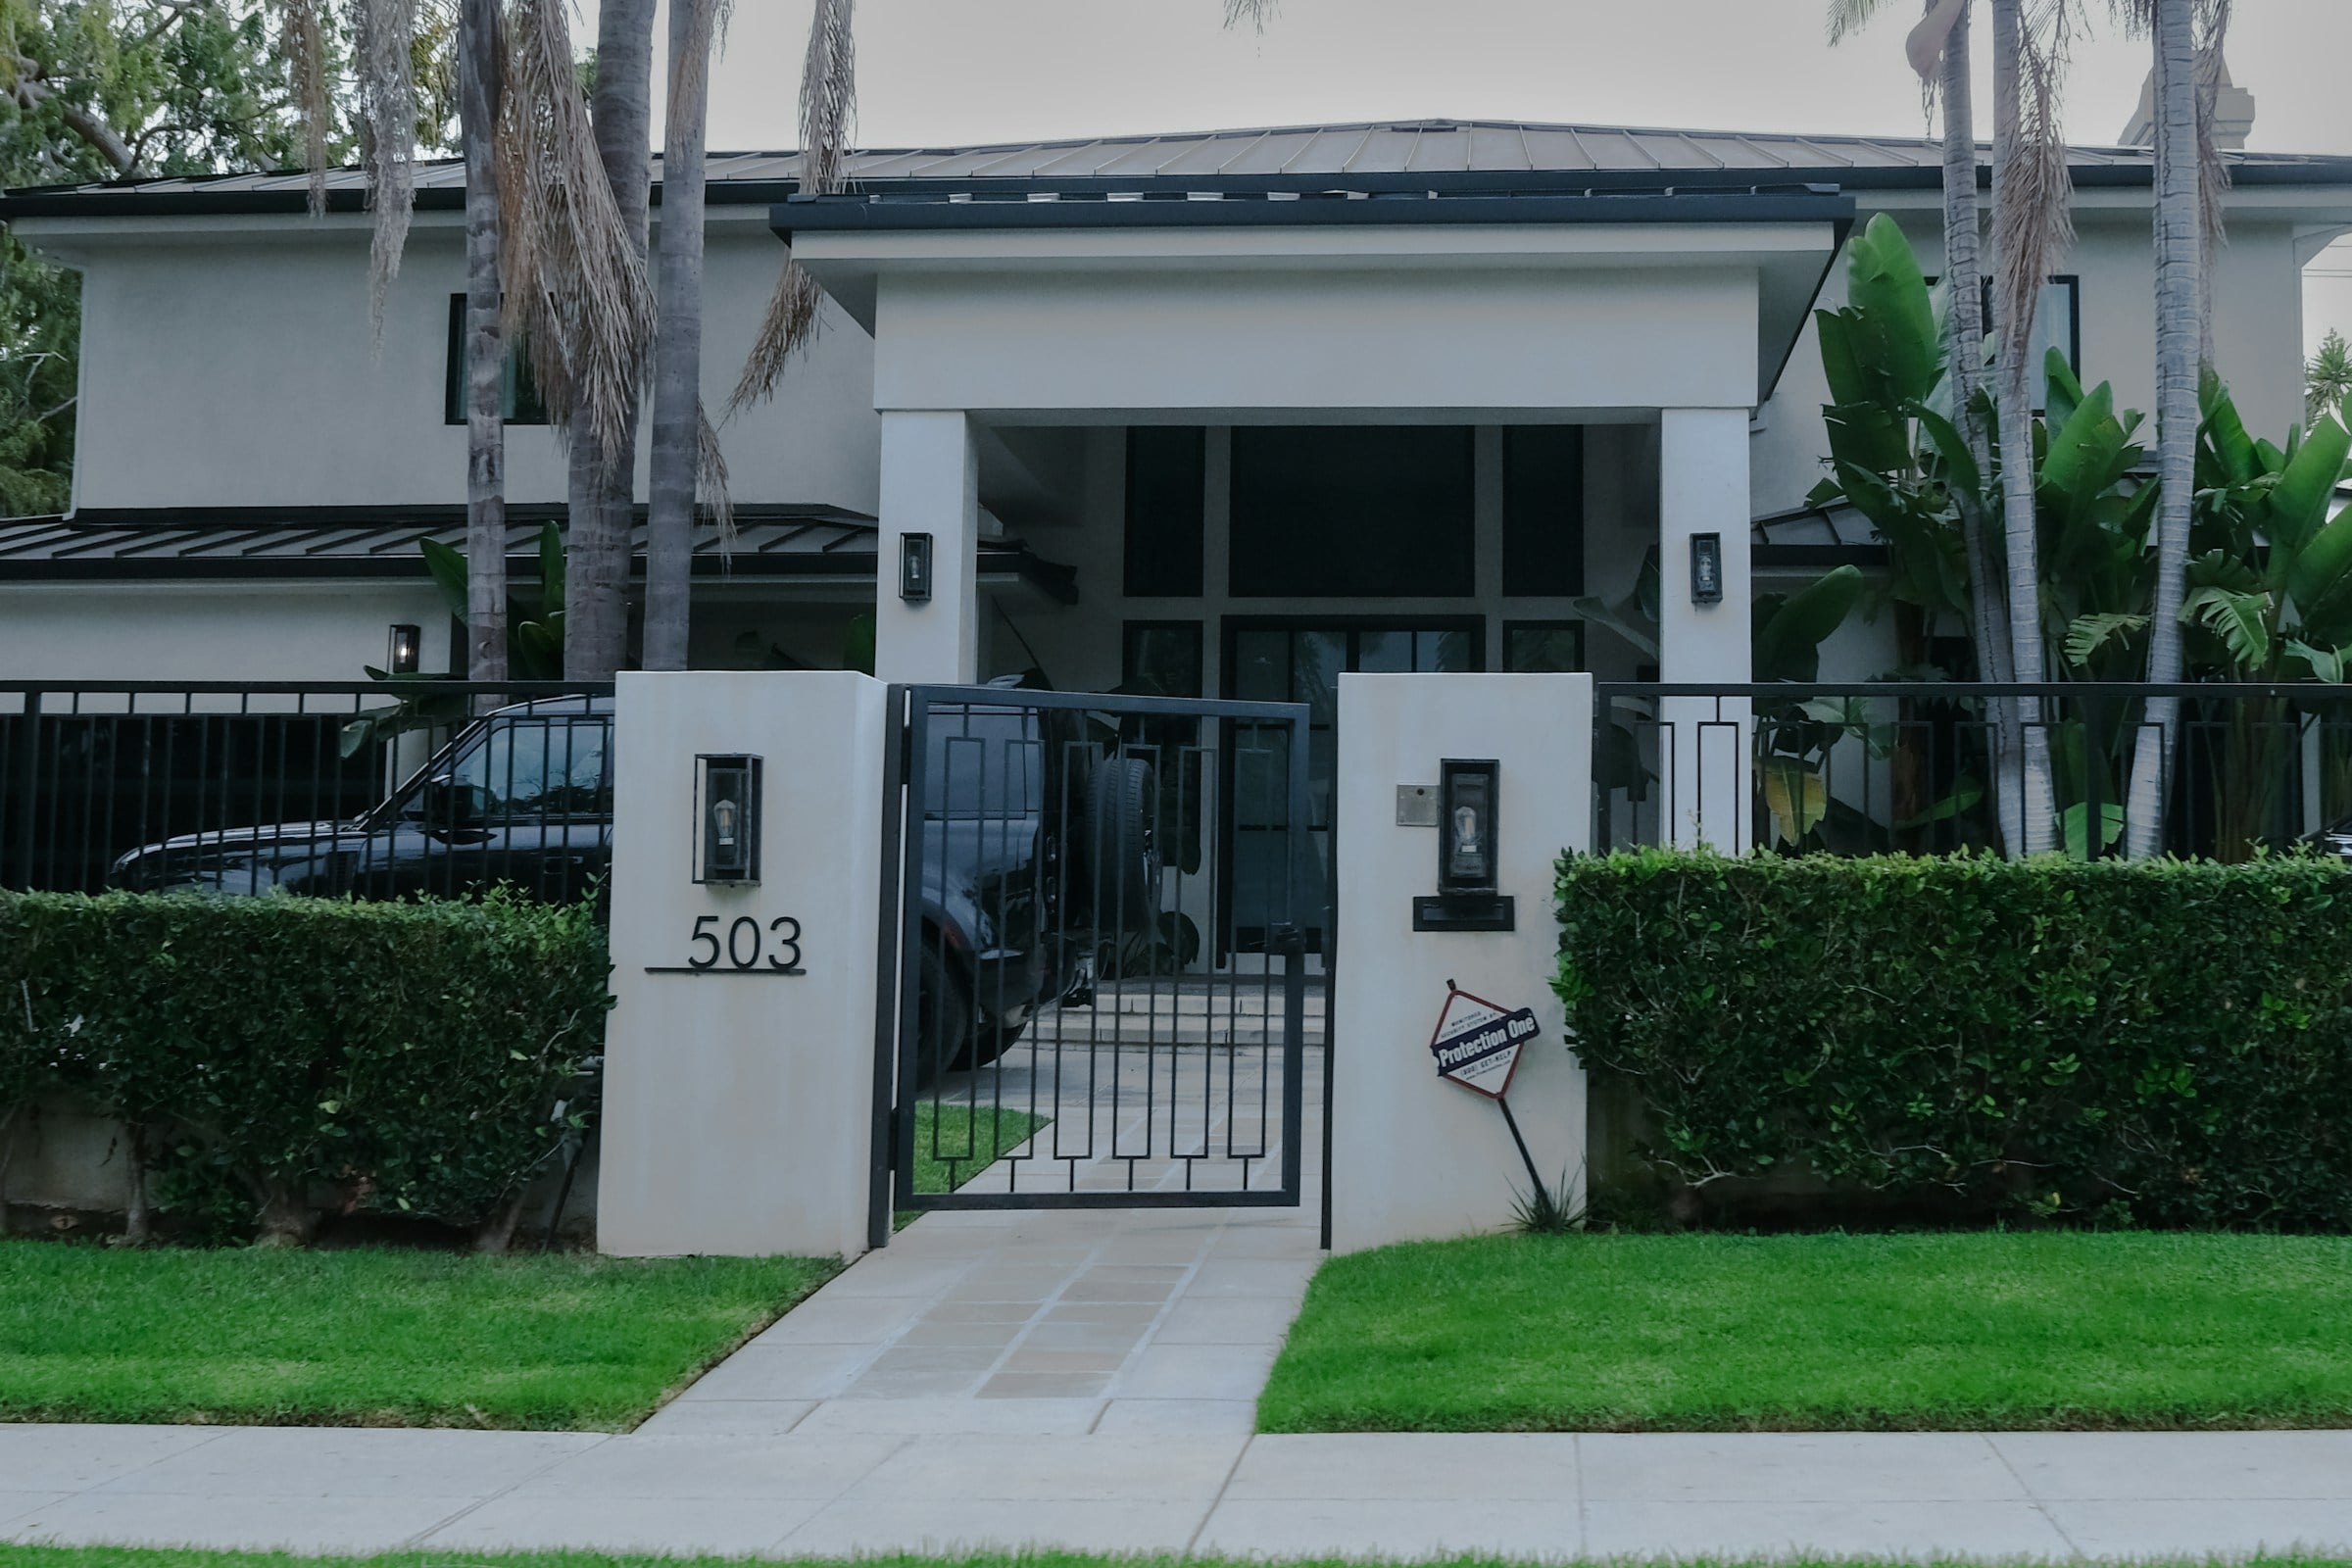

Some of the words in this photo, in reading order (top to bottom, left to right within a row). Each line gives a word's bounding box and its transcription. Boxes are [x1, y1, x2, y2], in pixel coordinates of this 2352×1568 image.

[688, 915, 802, 969] 503
[1439, 1028, 1508, 1067] Protection
[1507, 1016, 1536, 1039] One
